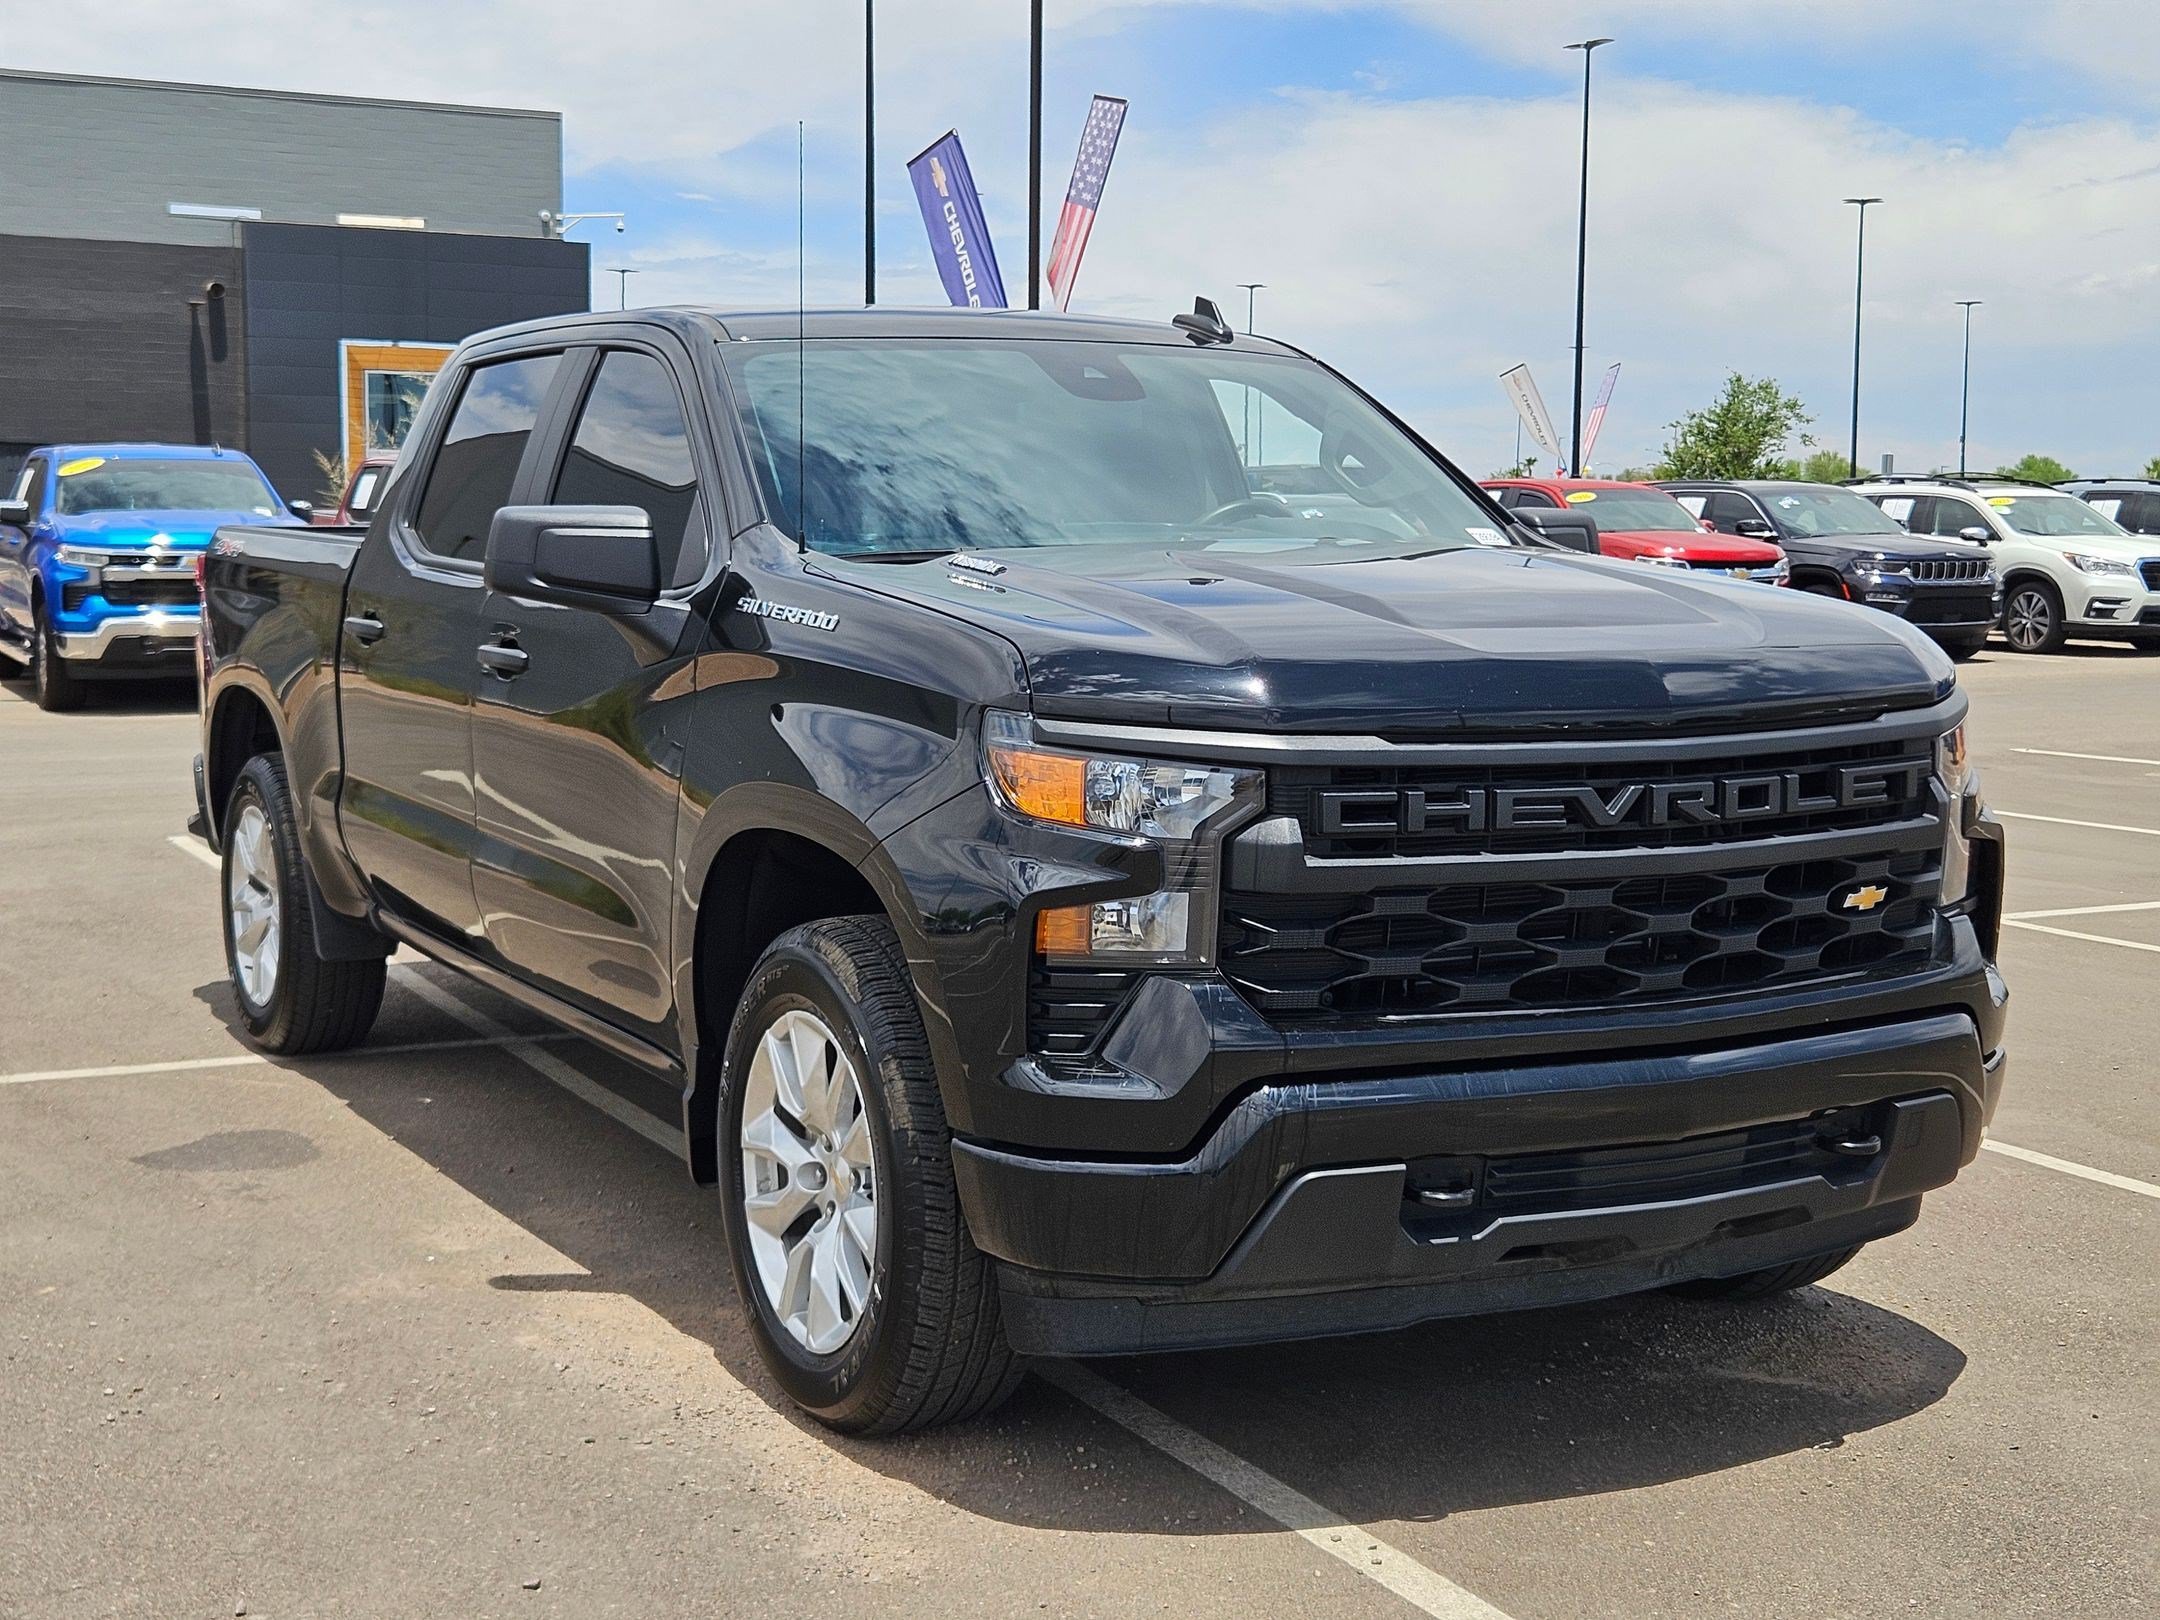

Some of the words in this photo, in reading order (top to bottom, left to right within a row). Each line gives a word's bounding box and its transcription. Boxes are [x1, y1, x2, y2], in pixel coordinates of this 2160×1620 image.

[1521, 393, 1547, 446] CHEVROLET
[736, 597, 840, 632] SILVERADO
[1316, 759, 1931, 835] CHEVROLET
